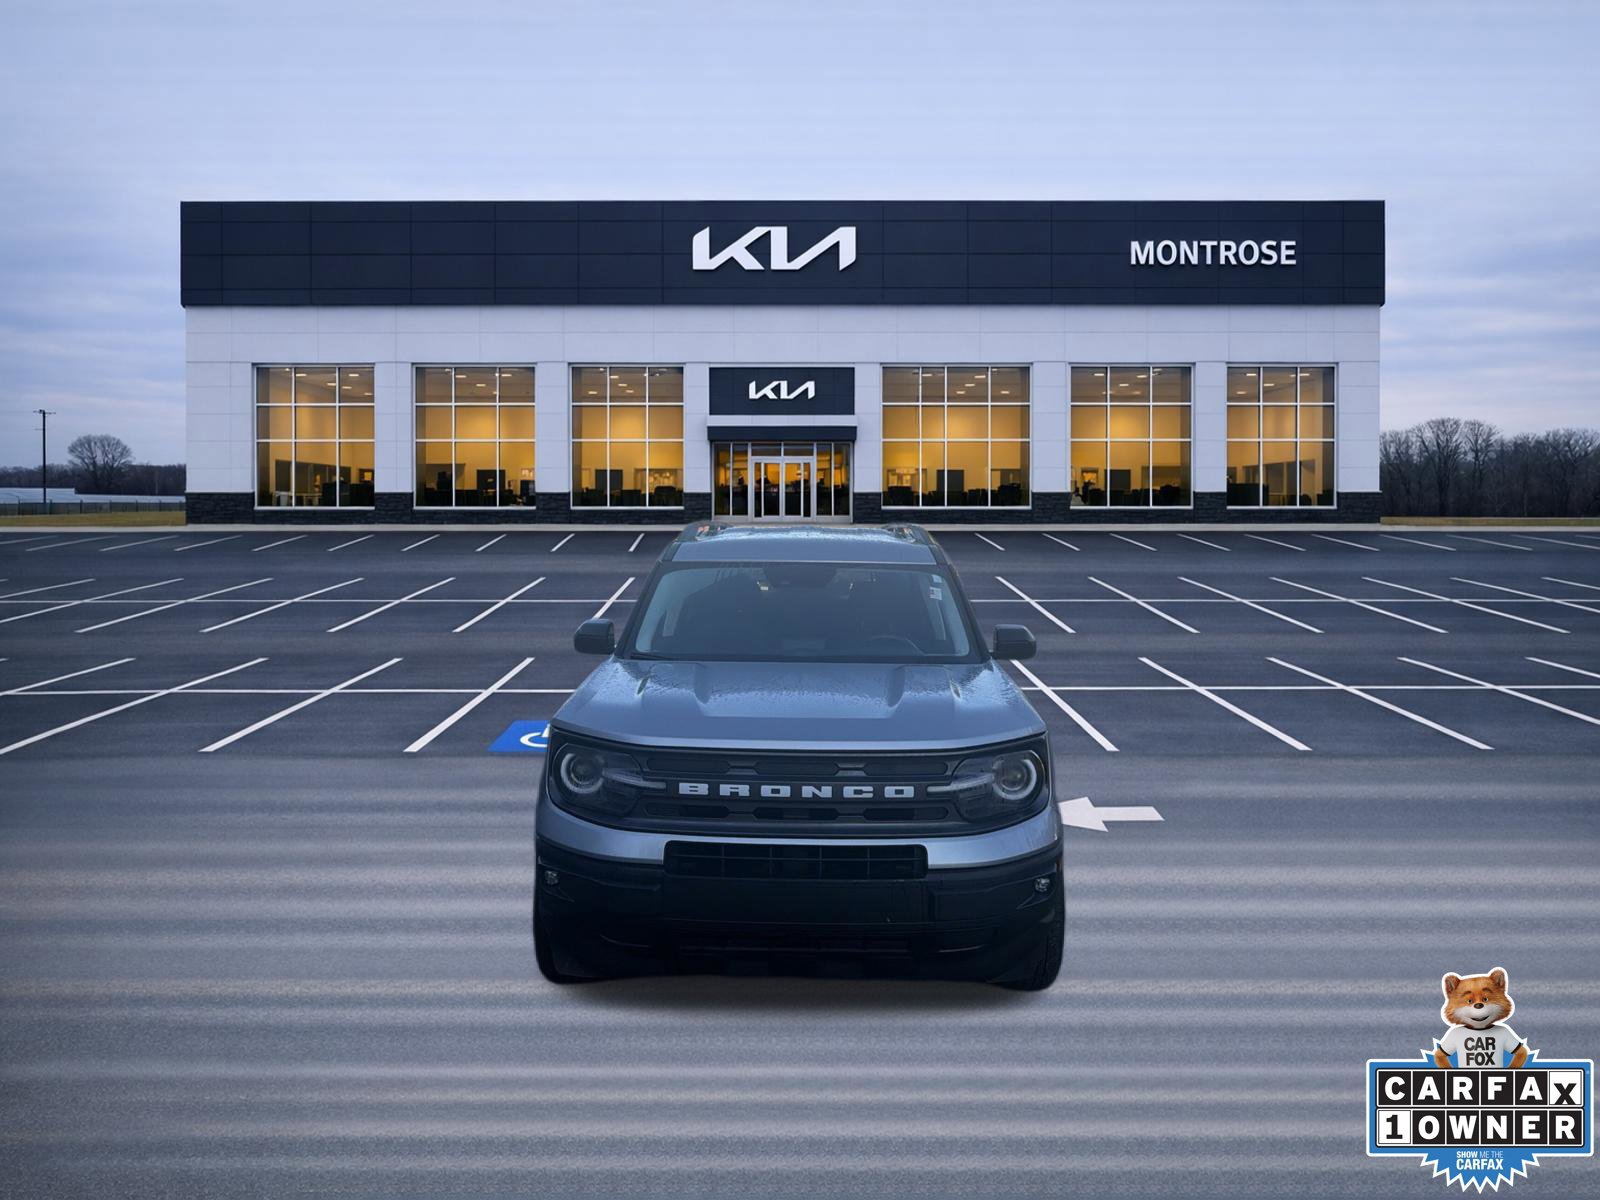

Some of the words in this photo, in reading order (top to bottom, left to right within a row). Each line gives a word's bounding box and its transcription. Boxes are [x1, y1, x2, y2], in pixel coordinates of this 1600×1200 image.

[692, 226, 857, 271] KIA
[1130, 239, 1297, 266] MONTROSE
[748, 380, 816, 400] KIA
[678, 782, 915, 798] BRONCO
